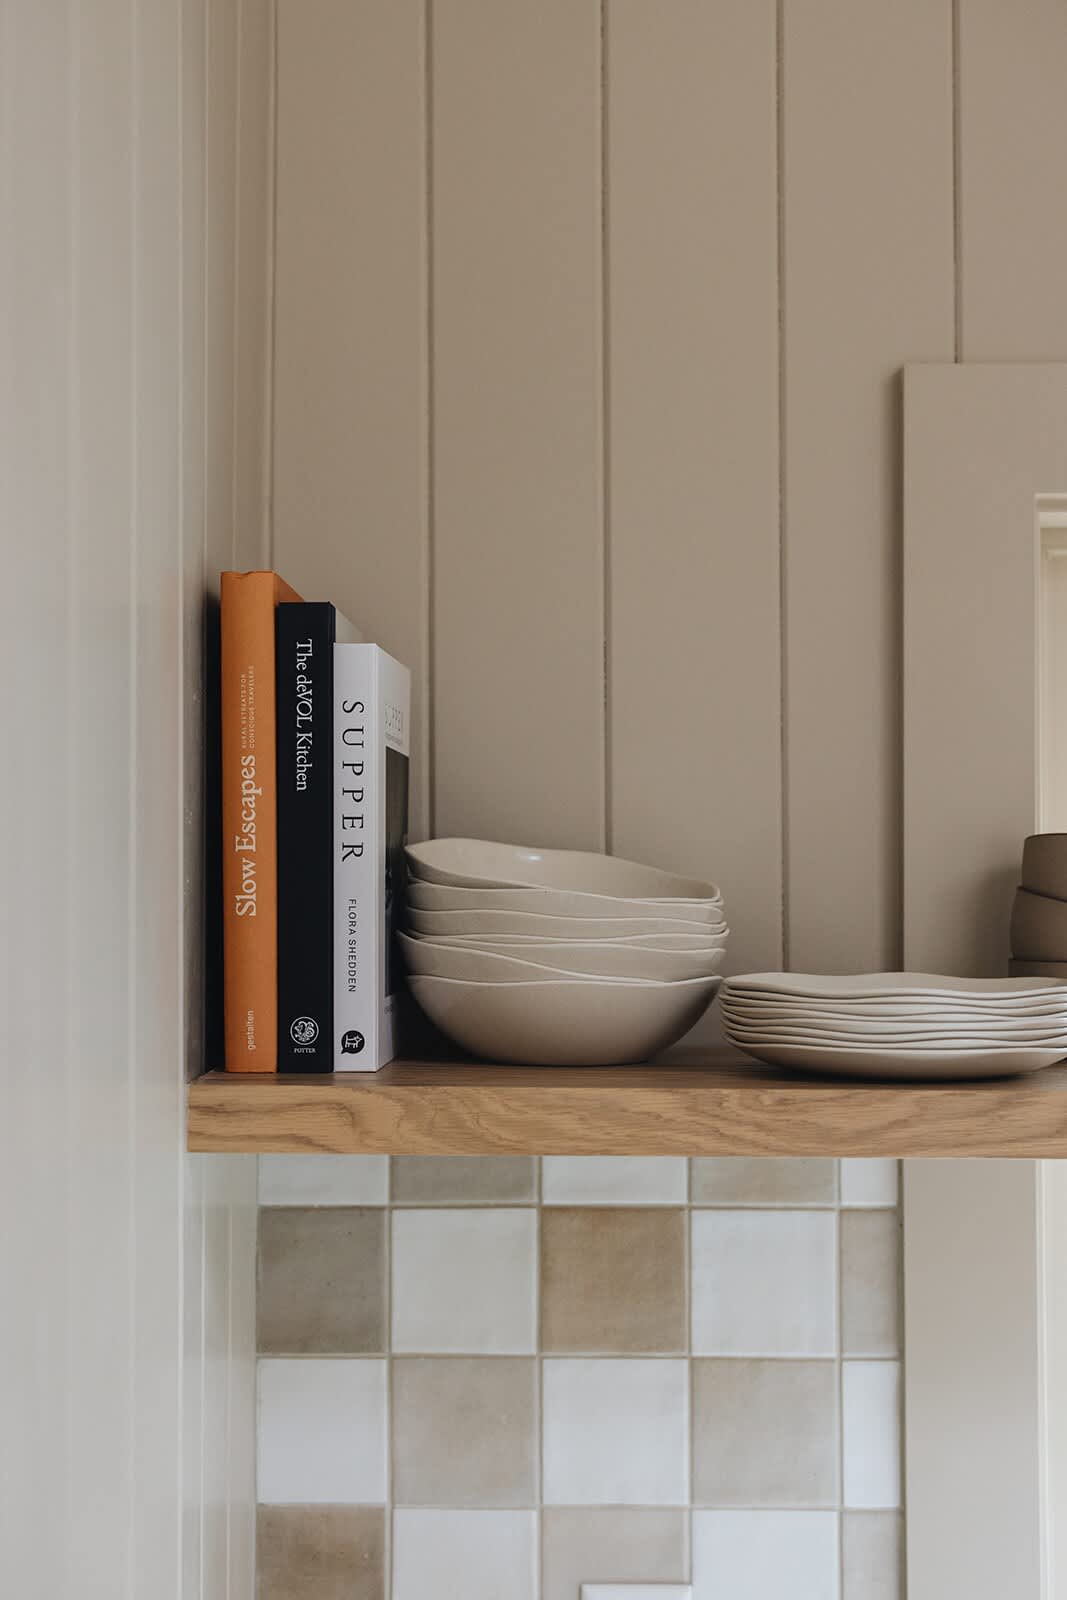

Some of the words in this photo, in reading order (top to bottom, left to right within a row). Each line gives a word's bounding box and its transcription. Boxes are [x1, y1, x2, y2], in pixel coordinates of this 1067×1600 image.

[296, 638, 313, 671] The
[296, 674, 313, 729] deVOL
[296, 732, 313, 792] Kitchen
[342, 700, 365, 863] SUPPER
[236, 755, 262, 852] Escapes
[236, 858, 257, 916] Slow
[348, 898, 357, 936] FLORA
[348, 939, 357, 993] SHEDDEN
[247, 1010, 256, 1051] gestalten
[293, 1047, 317, 1055] POTTER
